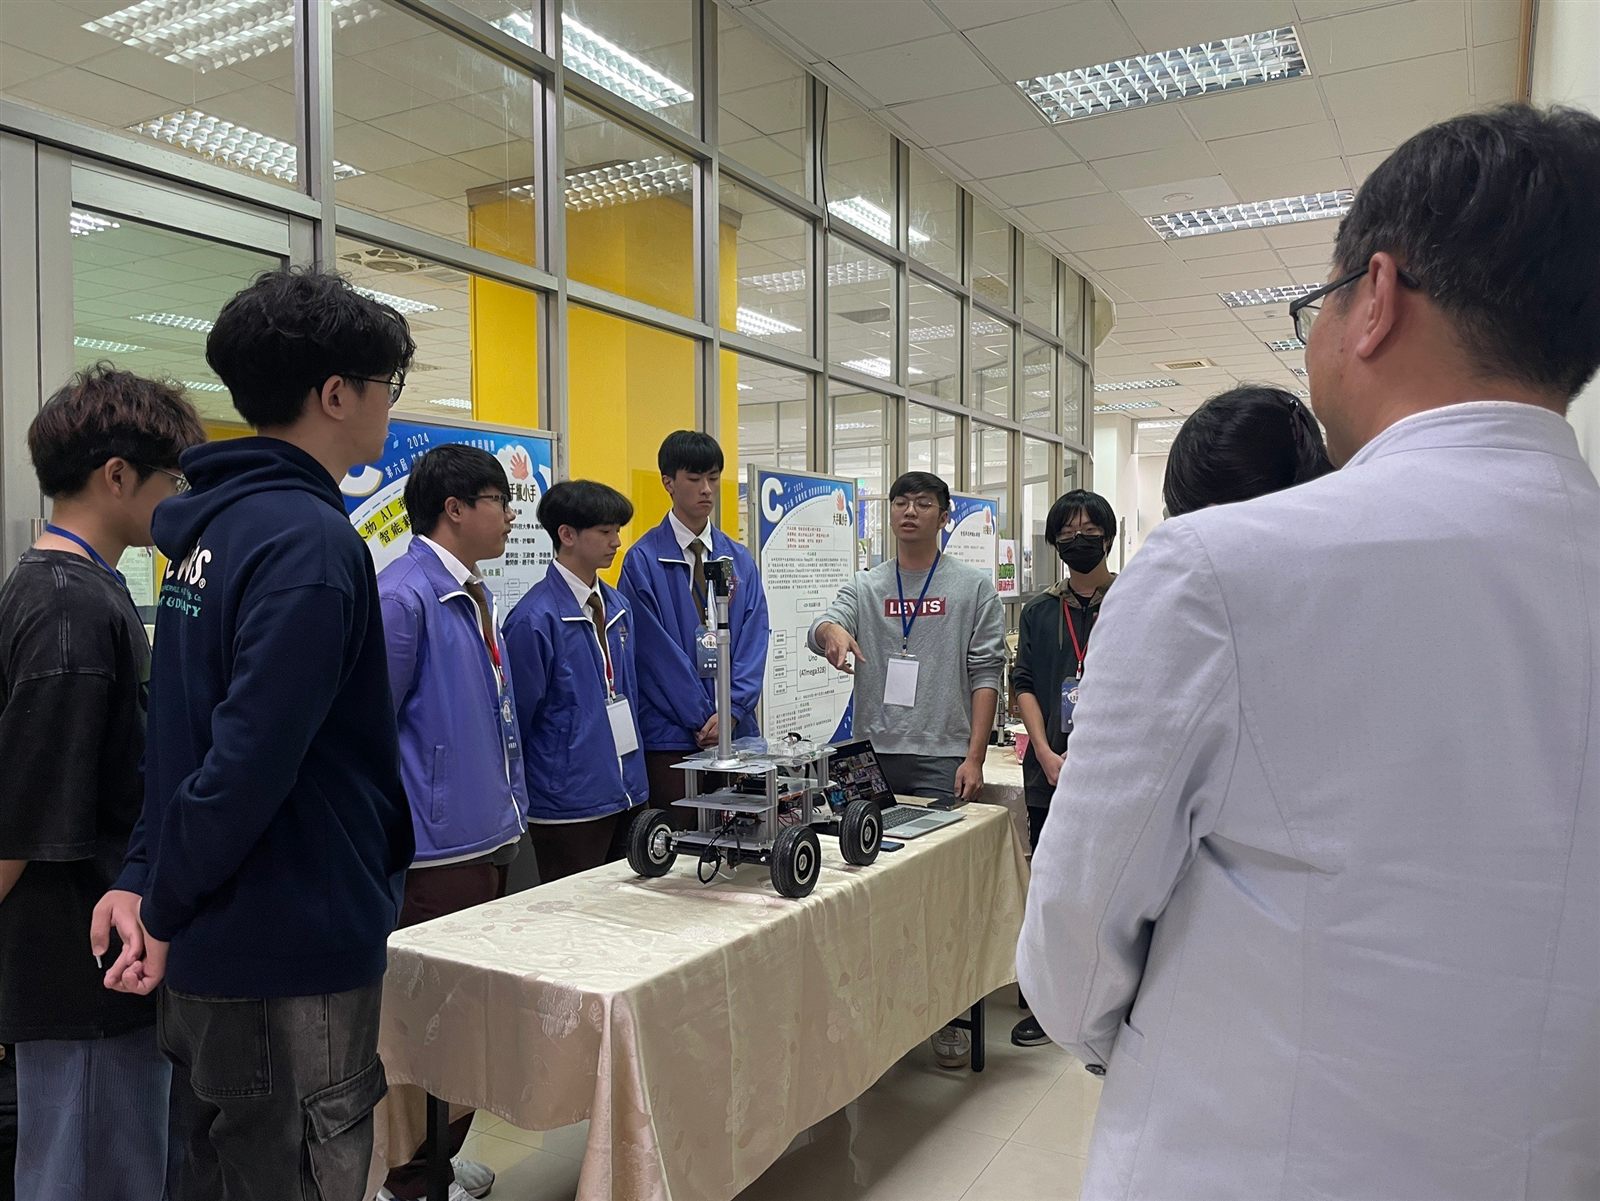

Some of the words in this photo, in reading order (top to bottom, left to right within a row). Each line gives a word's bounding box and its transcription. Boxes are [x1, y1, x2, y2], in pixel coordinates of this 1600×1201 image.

[407, 432, 430, 449] 2024
[385, 458, 408, 479] 第六屆
[380, 505, 393, 523] AI
[889, 600, 941, 615] LEVI'S
